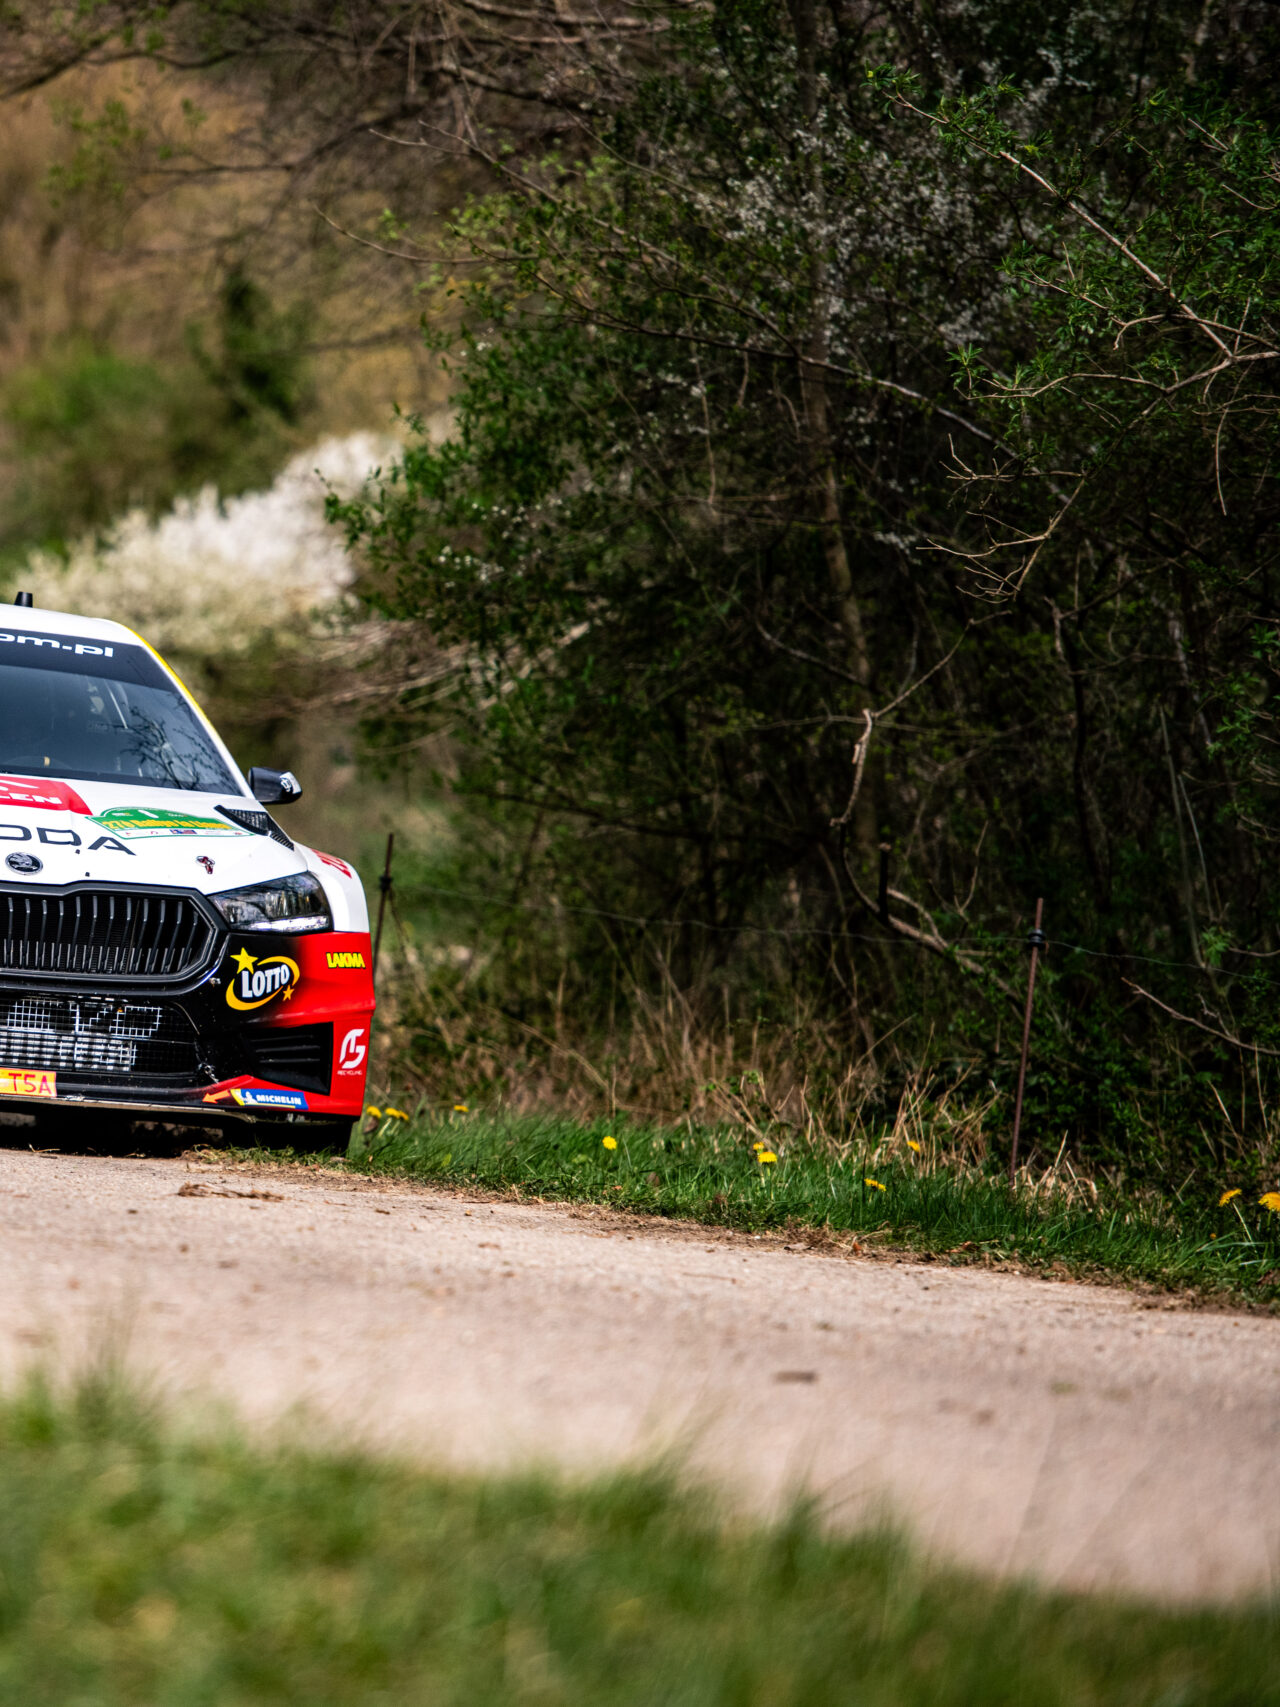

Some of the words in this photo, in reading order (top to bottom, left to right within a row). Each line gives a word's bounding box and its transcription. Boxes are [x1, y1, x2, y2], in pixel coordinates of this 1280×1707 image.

[326, 951, 366, 969] LAKMA
[241, 964, 291, 998] LOTTO
[256, 1094, 302, 1105] MICHELIN
